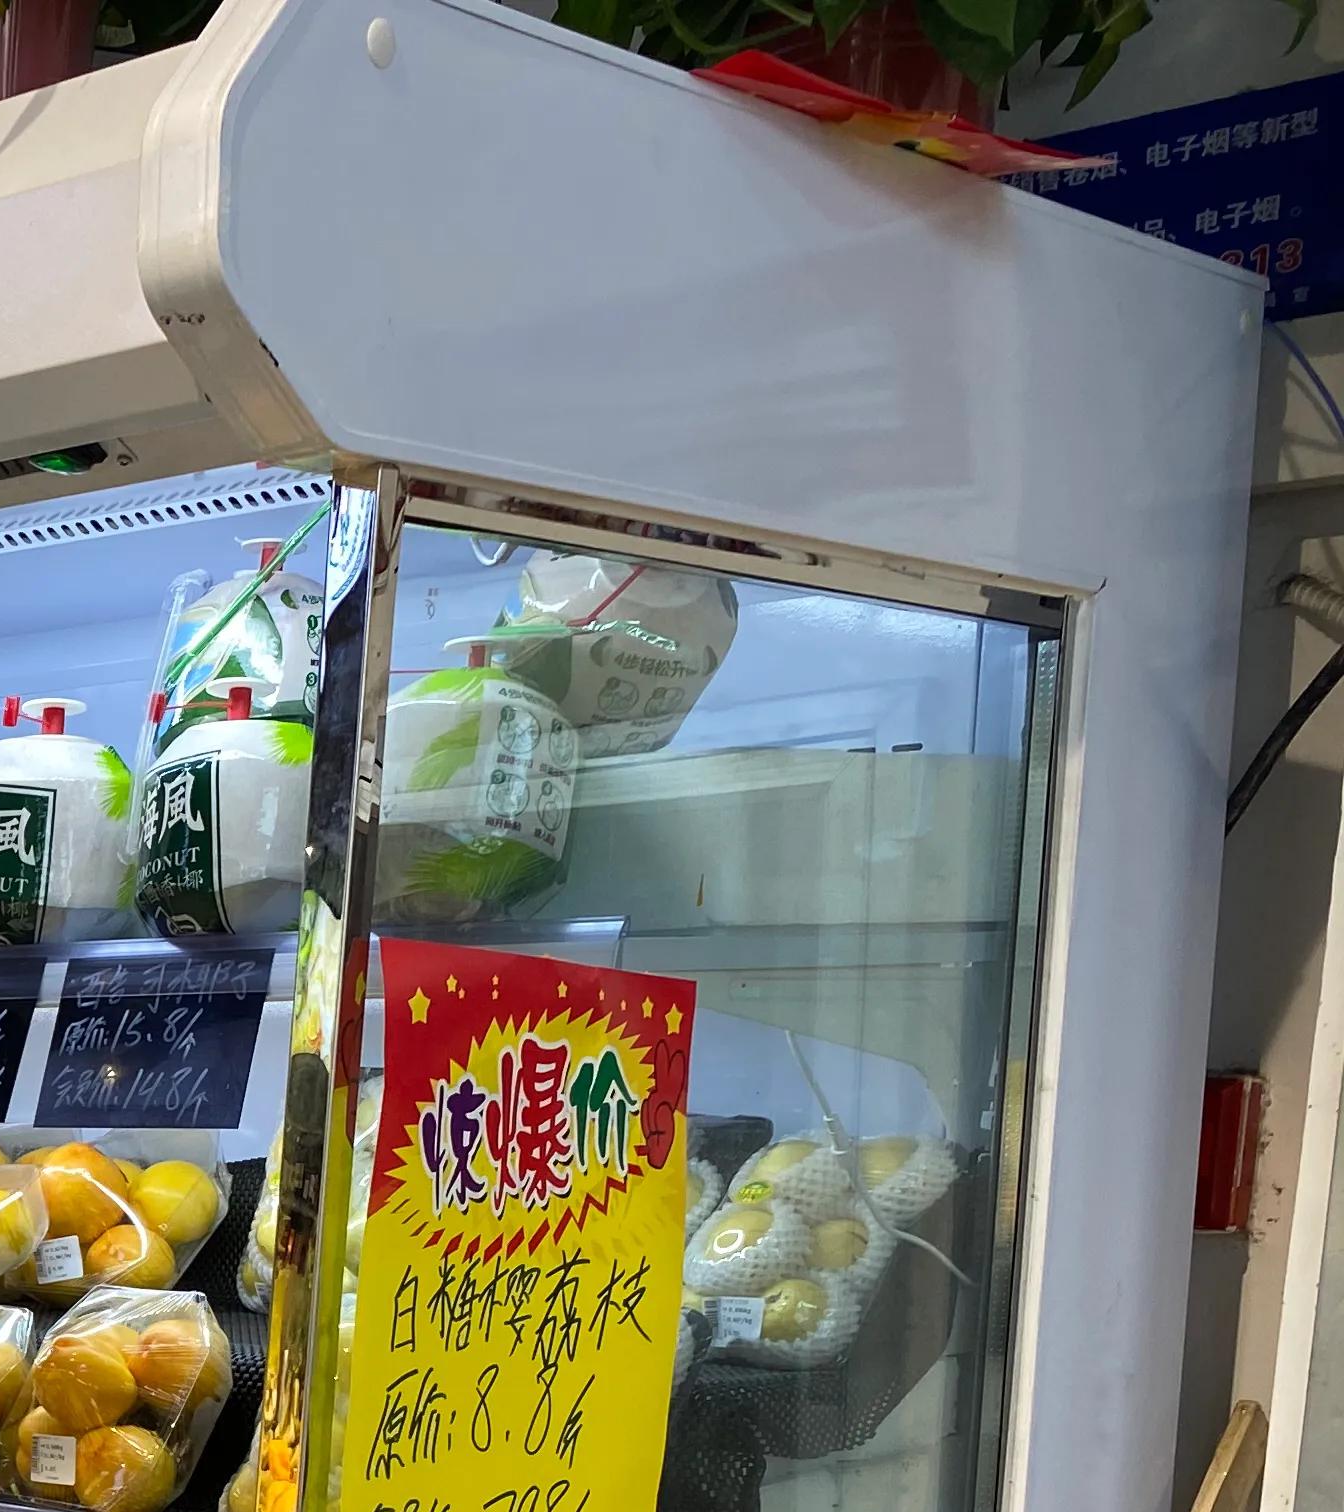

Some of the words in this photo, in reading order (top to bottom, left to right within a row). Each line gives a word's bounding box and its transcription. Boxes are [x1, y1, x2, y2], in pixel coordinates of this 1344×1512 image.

[136, 846, 201, 884] OCONUT
[420, 1036, 641, 1219] 惊爆价
